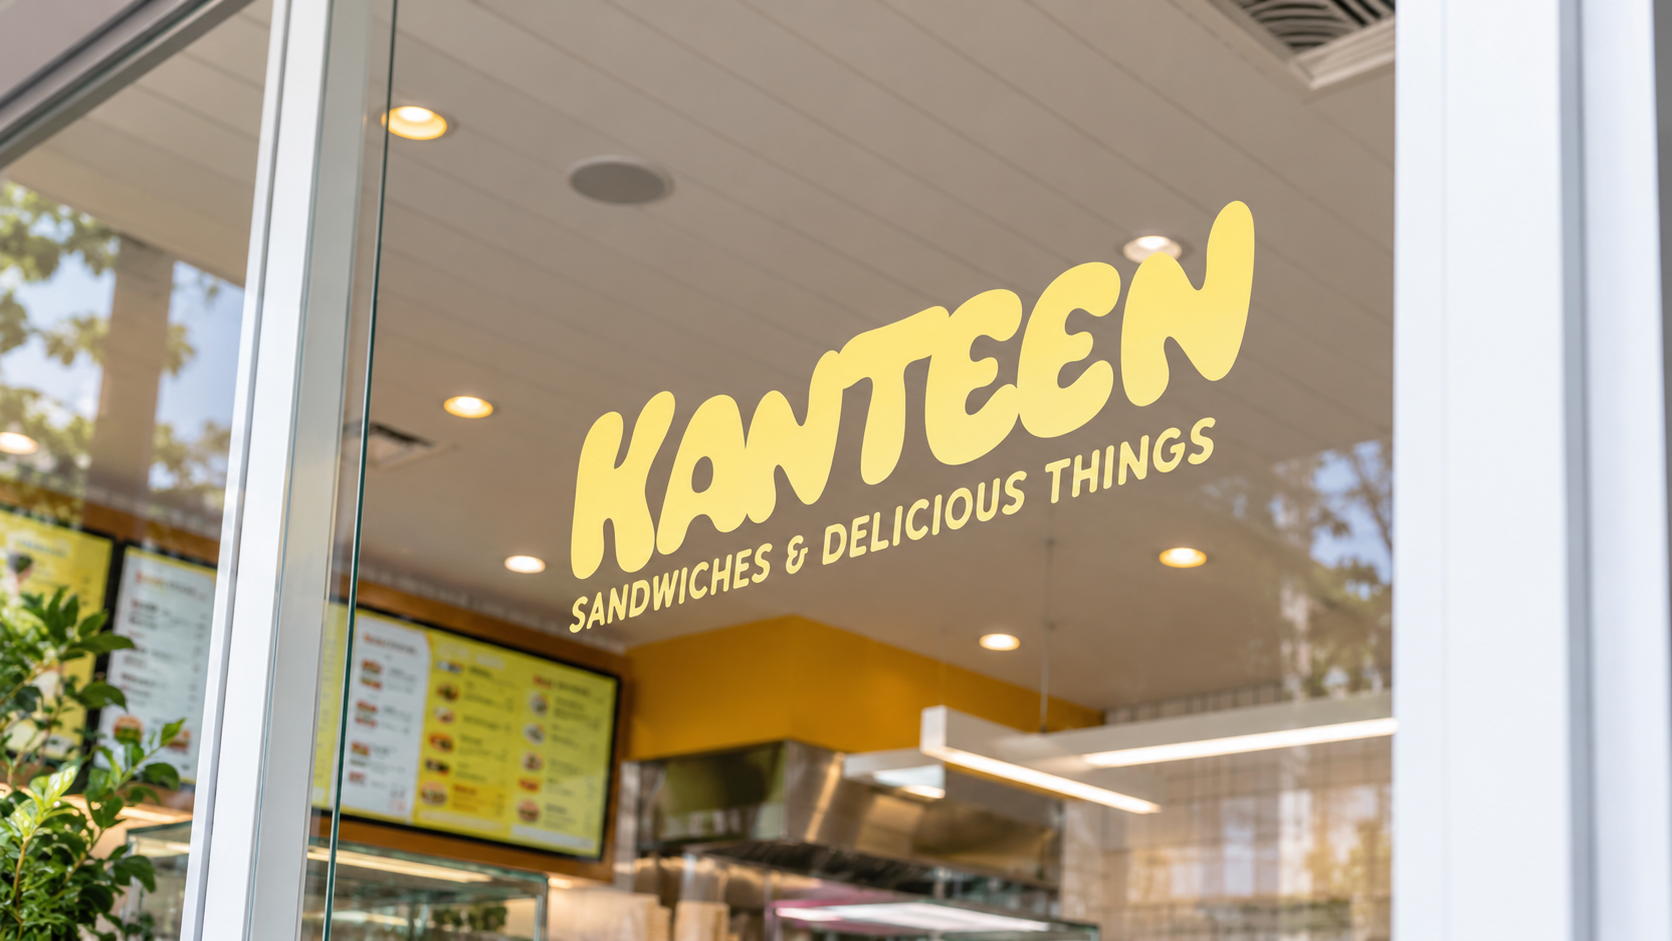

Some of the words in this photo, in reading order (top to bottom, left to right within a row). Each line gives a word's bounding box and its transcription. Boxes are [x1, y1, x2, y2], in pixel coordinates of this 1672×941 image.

[569, 543, 773, 633] SANDWICHES
[785, 535, 809, 574] &
[821, 471, 1028, 565] DELICIOUS
[1044, 416, 1216, 503] THINGS
[570, 200, 1255, 579] KANTEEN
